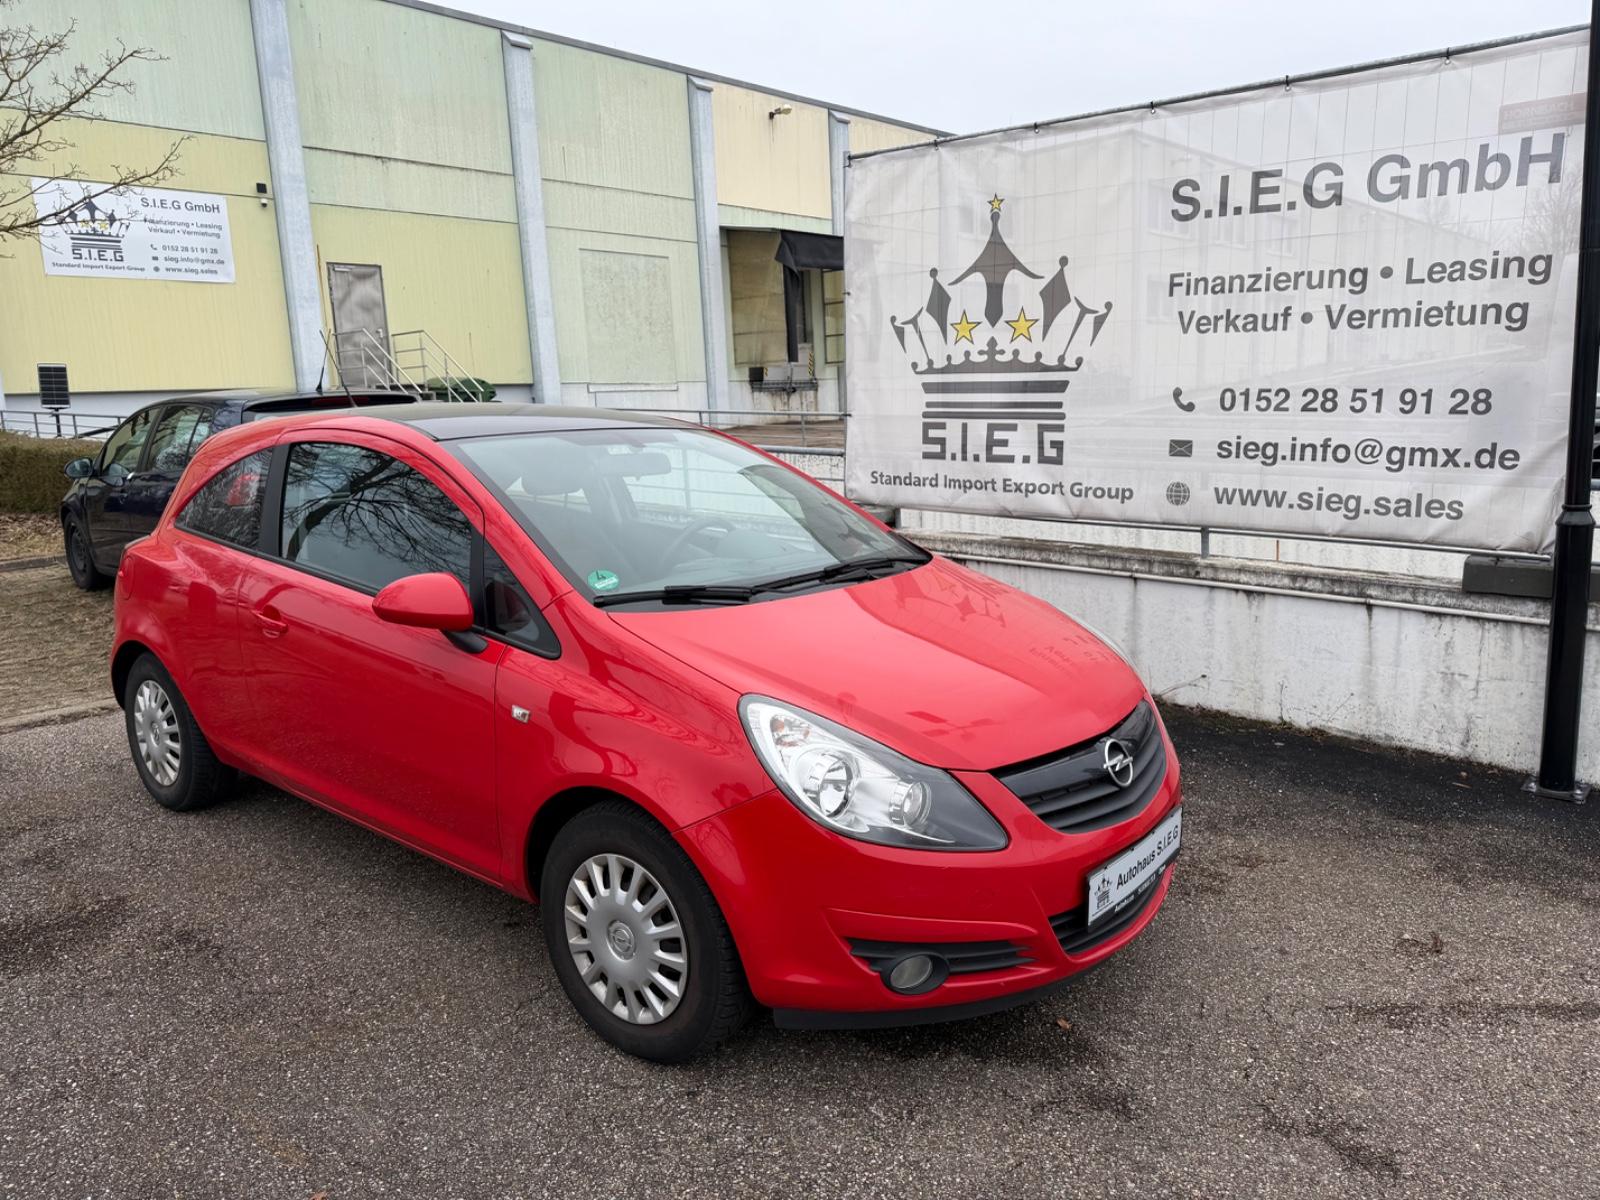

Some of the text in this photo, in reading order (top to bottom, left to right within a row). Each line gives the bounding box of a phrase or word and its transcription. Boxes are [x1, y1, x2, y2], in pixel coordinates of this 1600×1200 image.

[1171, 131, 1567, 222] S.I.E.G GmbH
[140, 197, 221, 213] S.I.E.G GmbH
[148, 226, 221, 239] Verkauf Vermietung
[195, 221, 223, 231] Leasing
[72, 249, 124, 261] S.I.E.G
[162, 244, 179, 252] 0152
[164, 256, 225, 265] sieg.info@gmx.de
[82, 263, 104, 271] Import
[165, 267, 218, 275] www.sieg.sales
[1168, 250, 1553, 297] Finanzierung Leasing
[1177, 300, 1530, 335] Verkauf Vermietung
[1219, 387, 1493, 416] 0152 28 51 91 28
[922, 421, 1065, 466] S.I.E.G
[1216, 435, 1521, 473] sieg.info@gmx.de
[870, 470, 1134, 504] Standard Import Export Group
[1213, 485, 1465, 521] www.sieg.sales
[1116, 851, 1156, 889] Autohaus
